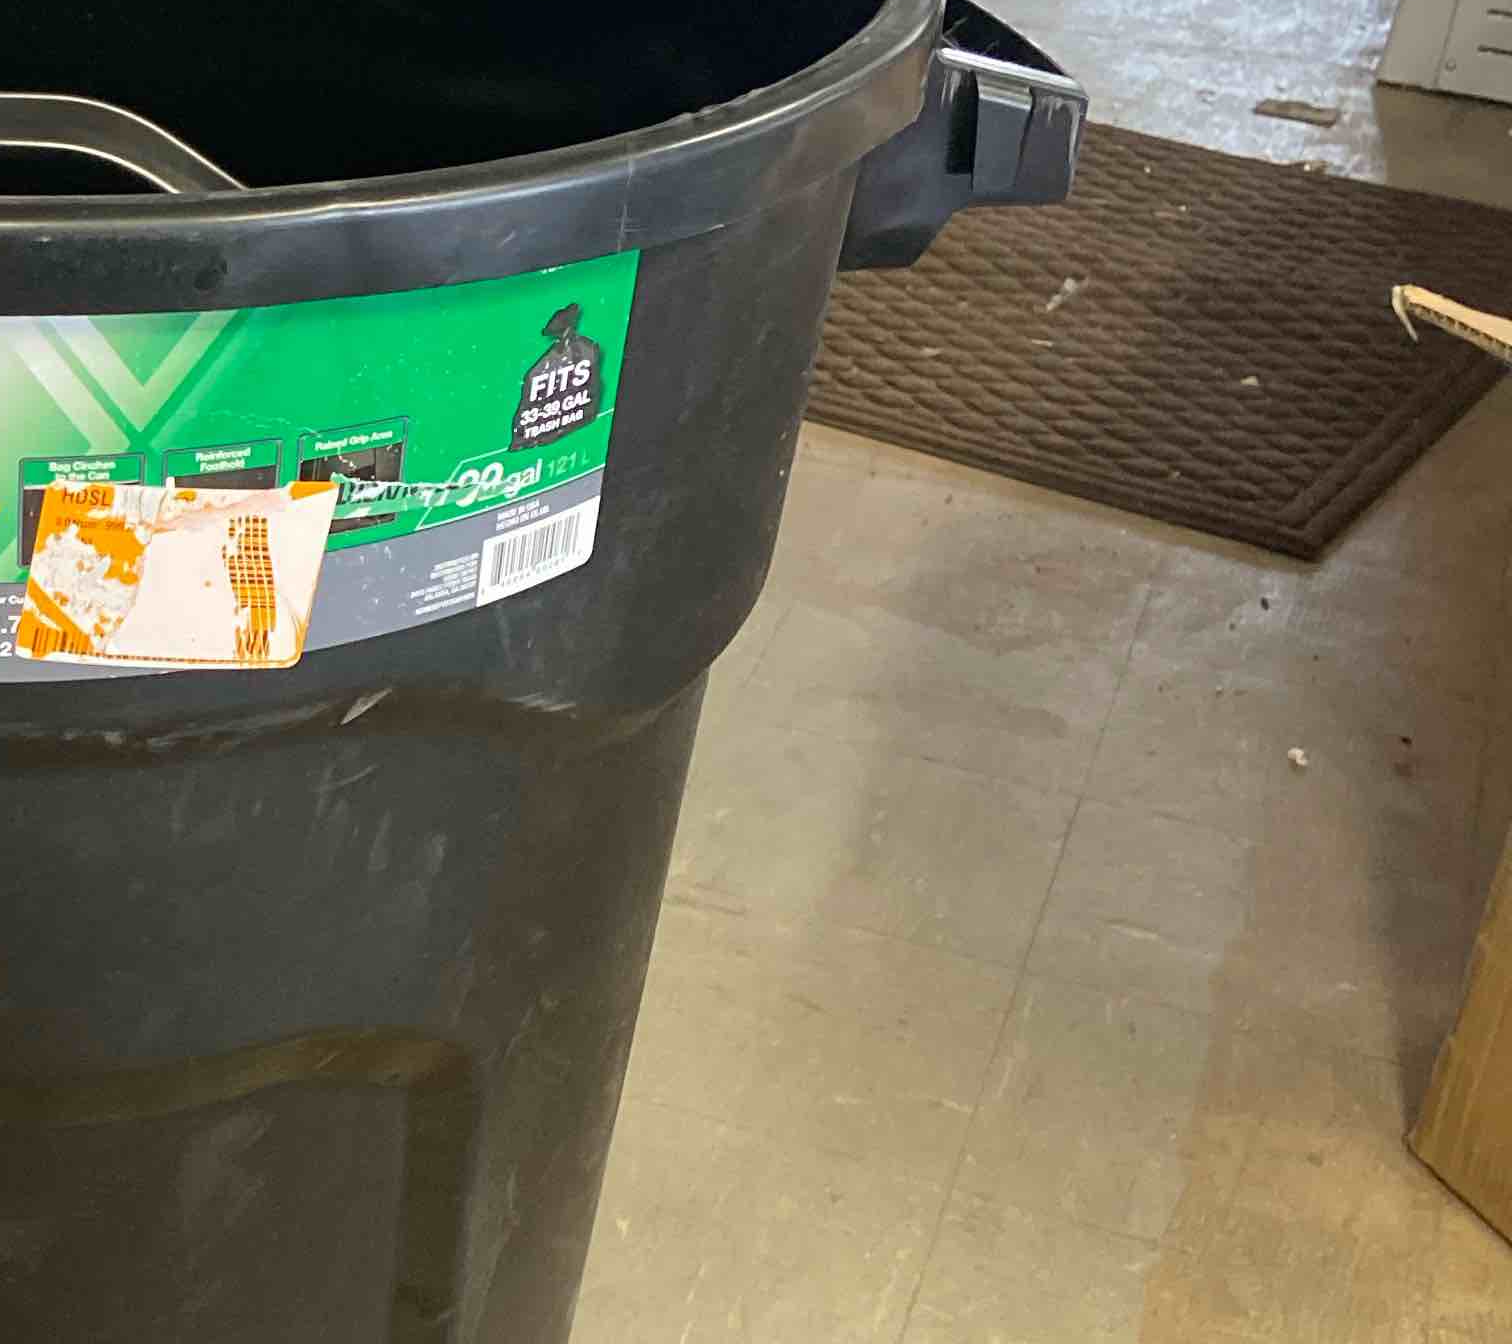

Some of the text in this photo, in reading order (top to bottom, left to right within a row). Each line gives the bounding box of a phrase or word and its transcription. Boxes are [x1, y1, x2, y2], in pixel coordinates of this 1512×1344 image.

[529, 359, 591, 402] FITS
[562, 390, 591, 411] GAL
[524, 409, 584, 440] TRASH BAG
[195, 447, 252, 463] Reinforced
[48, 461, 72, 474] Bag
[199, 457, 246, 473] Foothold
[547, 452, 577, 479] 121
[87, 470, 110, 481] Can
